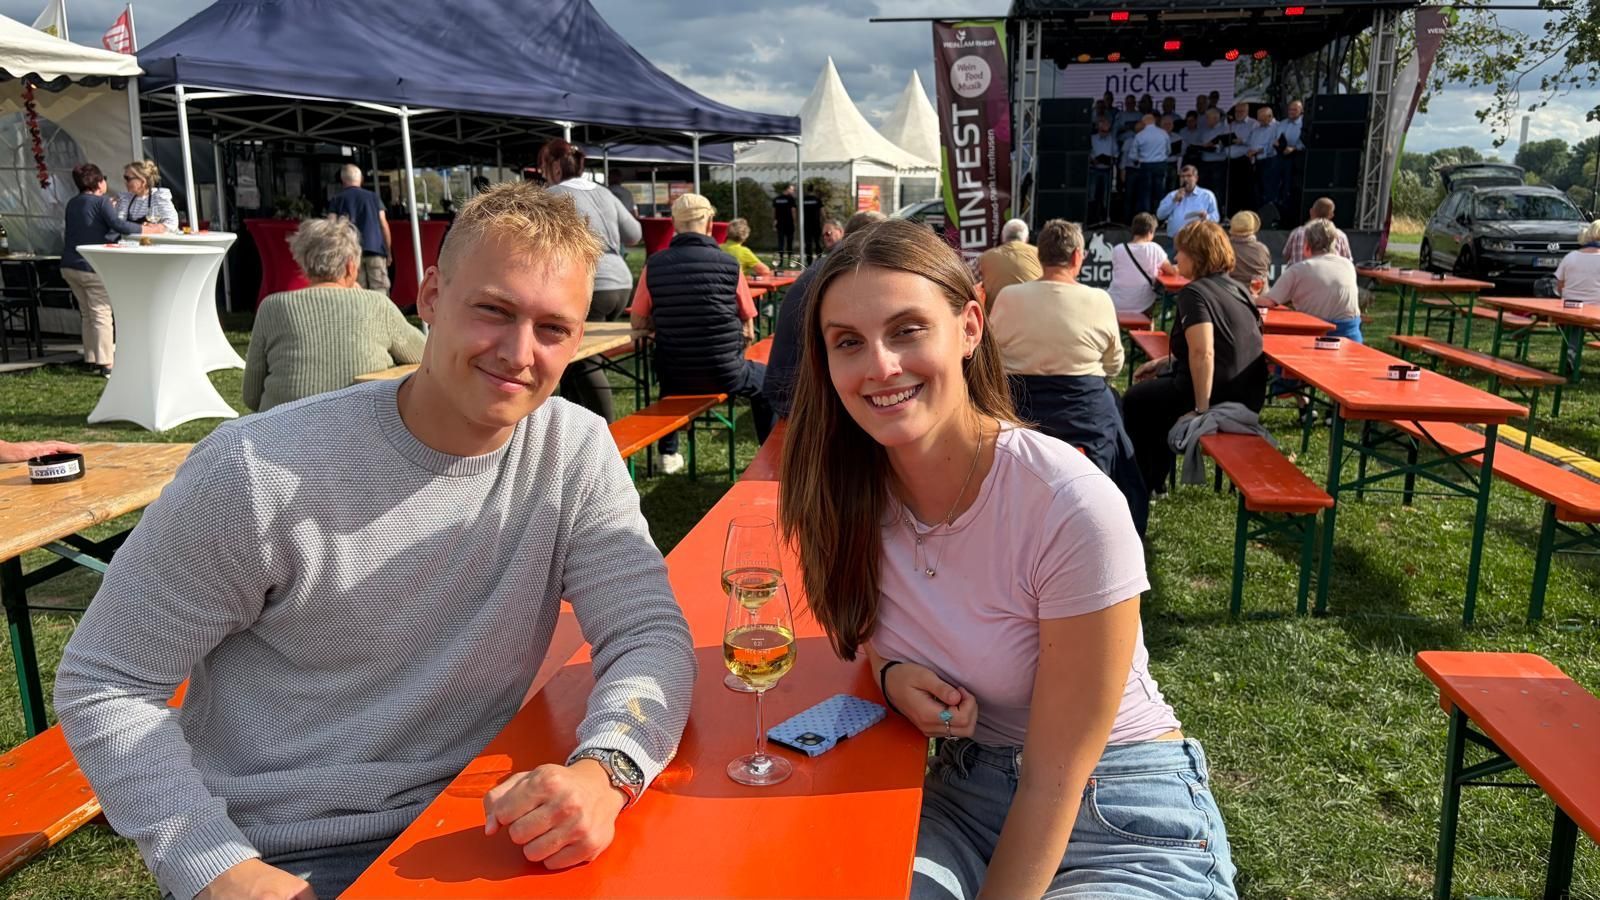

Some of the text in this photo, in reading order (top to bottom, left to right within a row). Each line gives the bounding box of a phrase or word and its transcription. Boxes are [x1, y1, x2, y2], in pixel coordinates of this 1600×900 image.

[964, 40, 974, 48] AM
[957, 64, 976, 72] Wein
[965, 72, 983, 81] Food
[1106, 67, 1189, 93] nickut
[958, 82, 981, 91] Musik
[987, 129, 997, 180] Leverkusen
